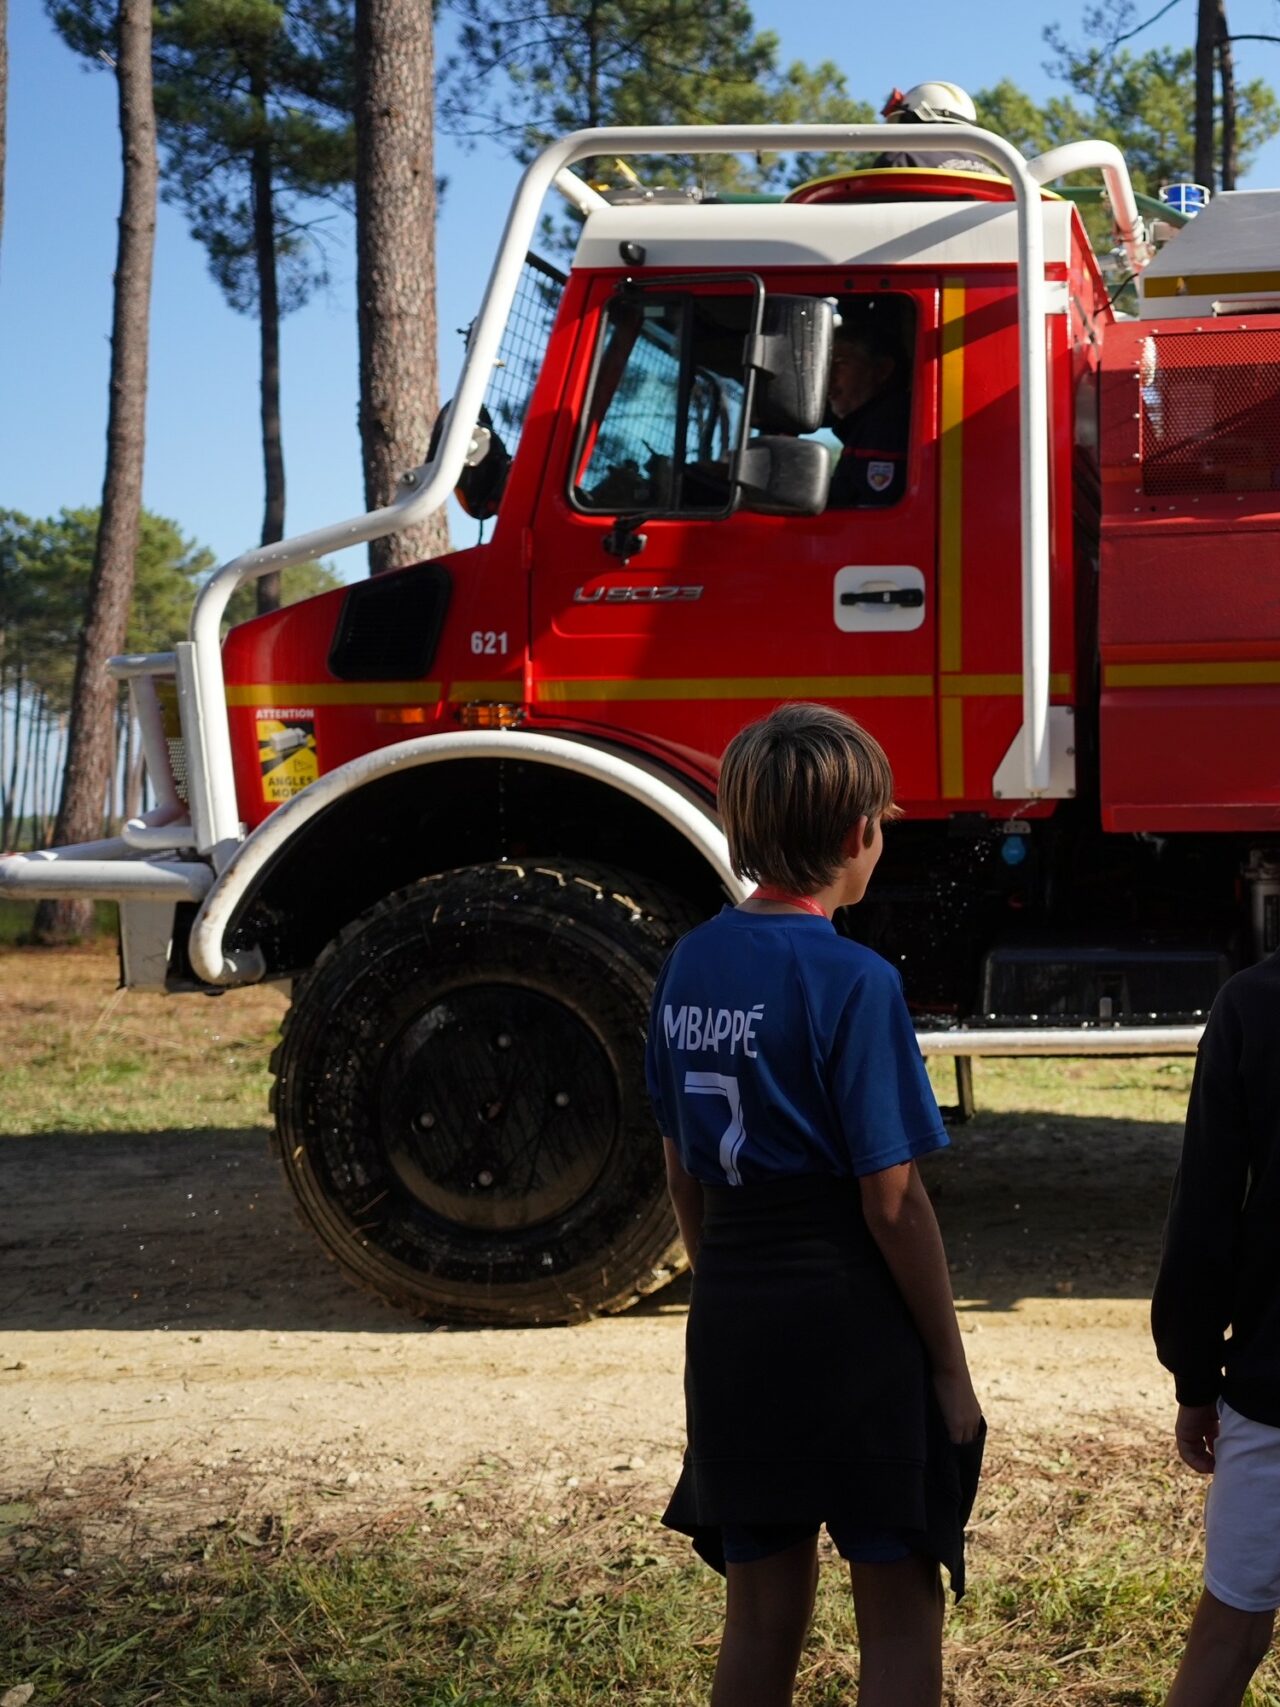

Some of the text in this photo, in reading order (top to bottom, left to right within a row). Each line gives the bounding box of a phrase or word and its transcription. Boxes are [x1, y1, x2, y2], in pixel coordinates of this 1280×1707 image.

[471, 631, 508, 655] 621
[256, 708, 314, 719] ATTENTION
[268, 776, 314, 787] ANGLES
[663, 1004, 765, 1059] MBAPPÉ
[684, 1071, 747, 1186] 7
